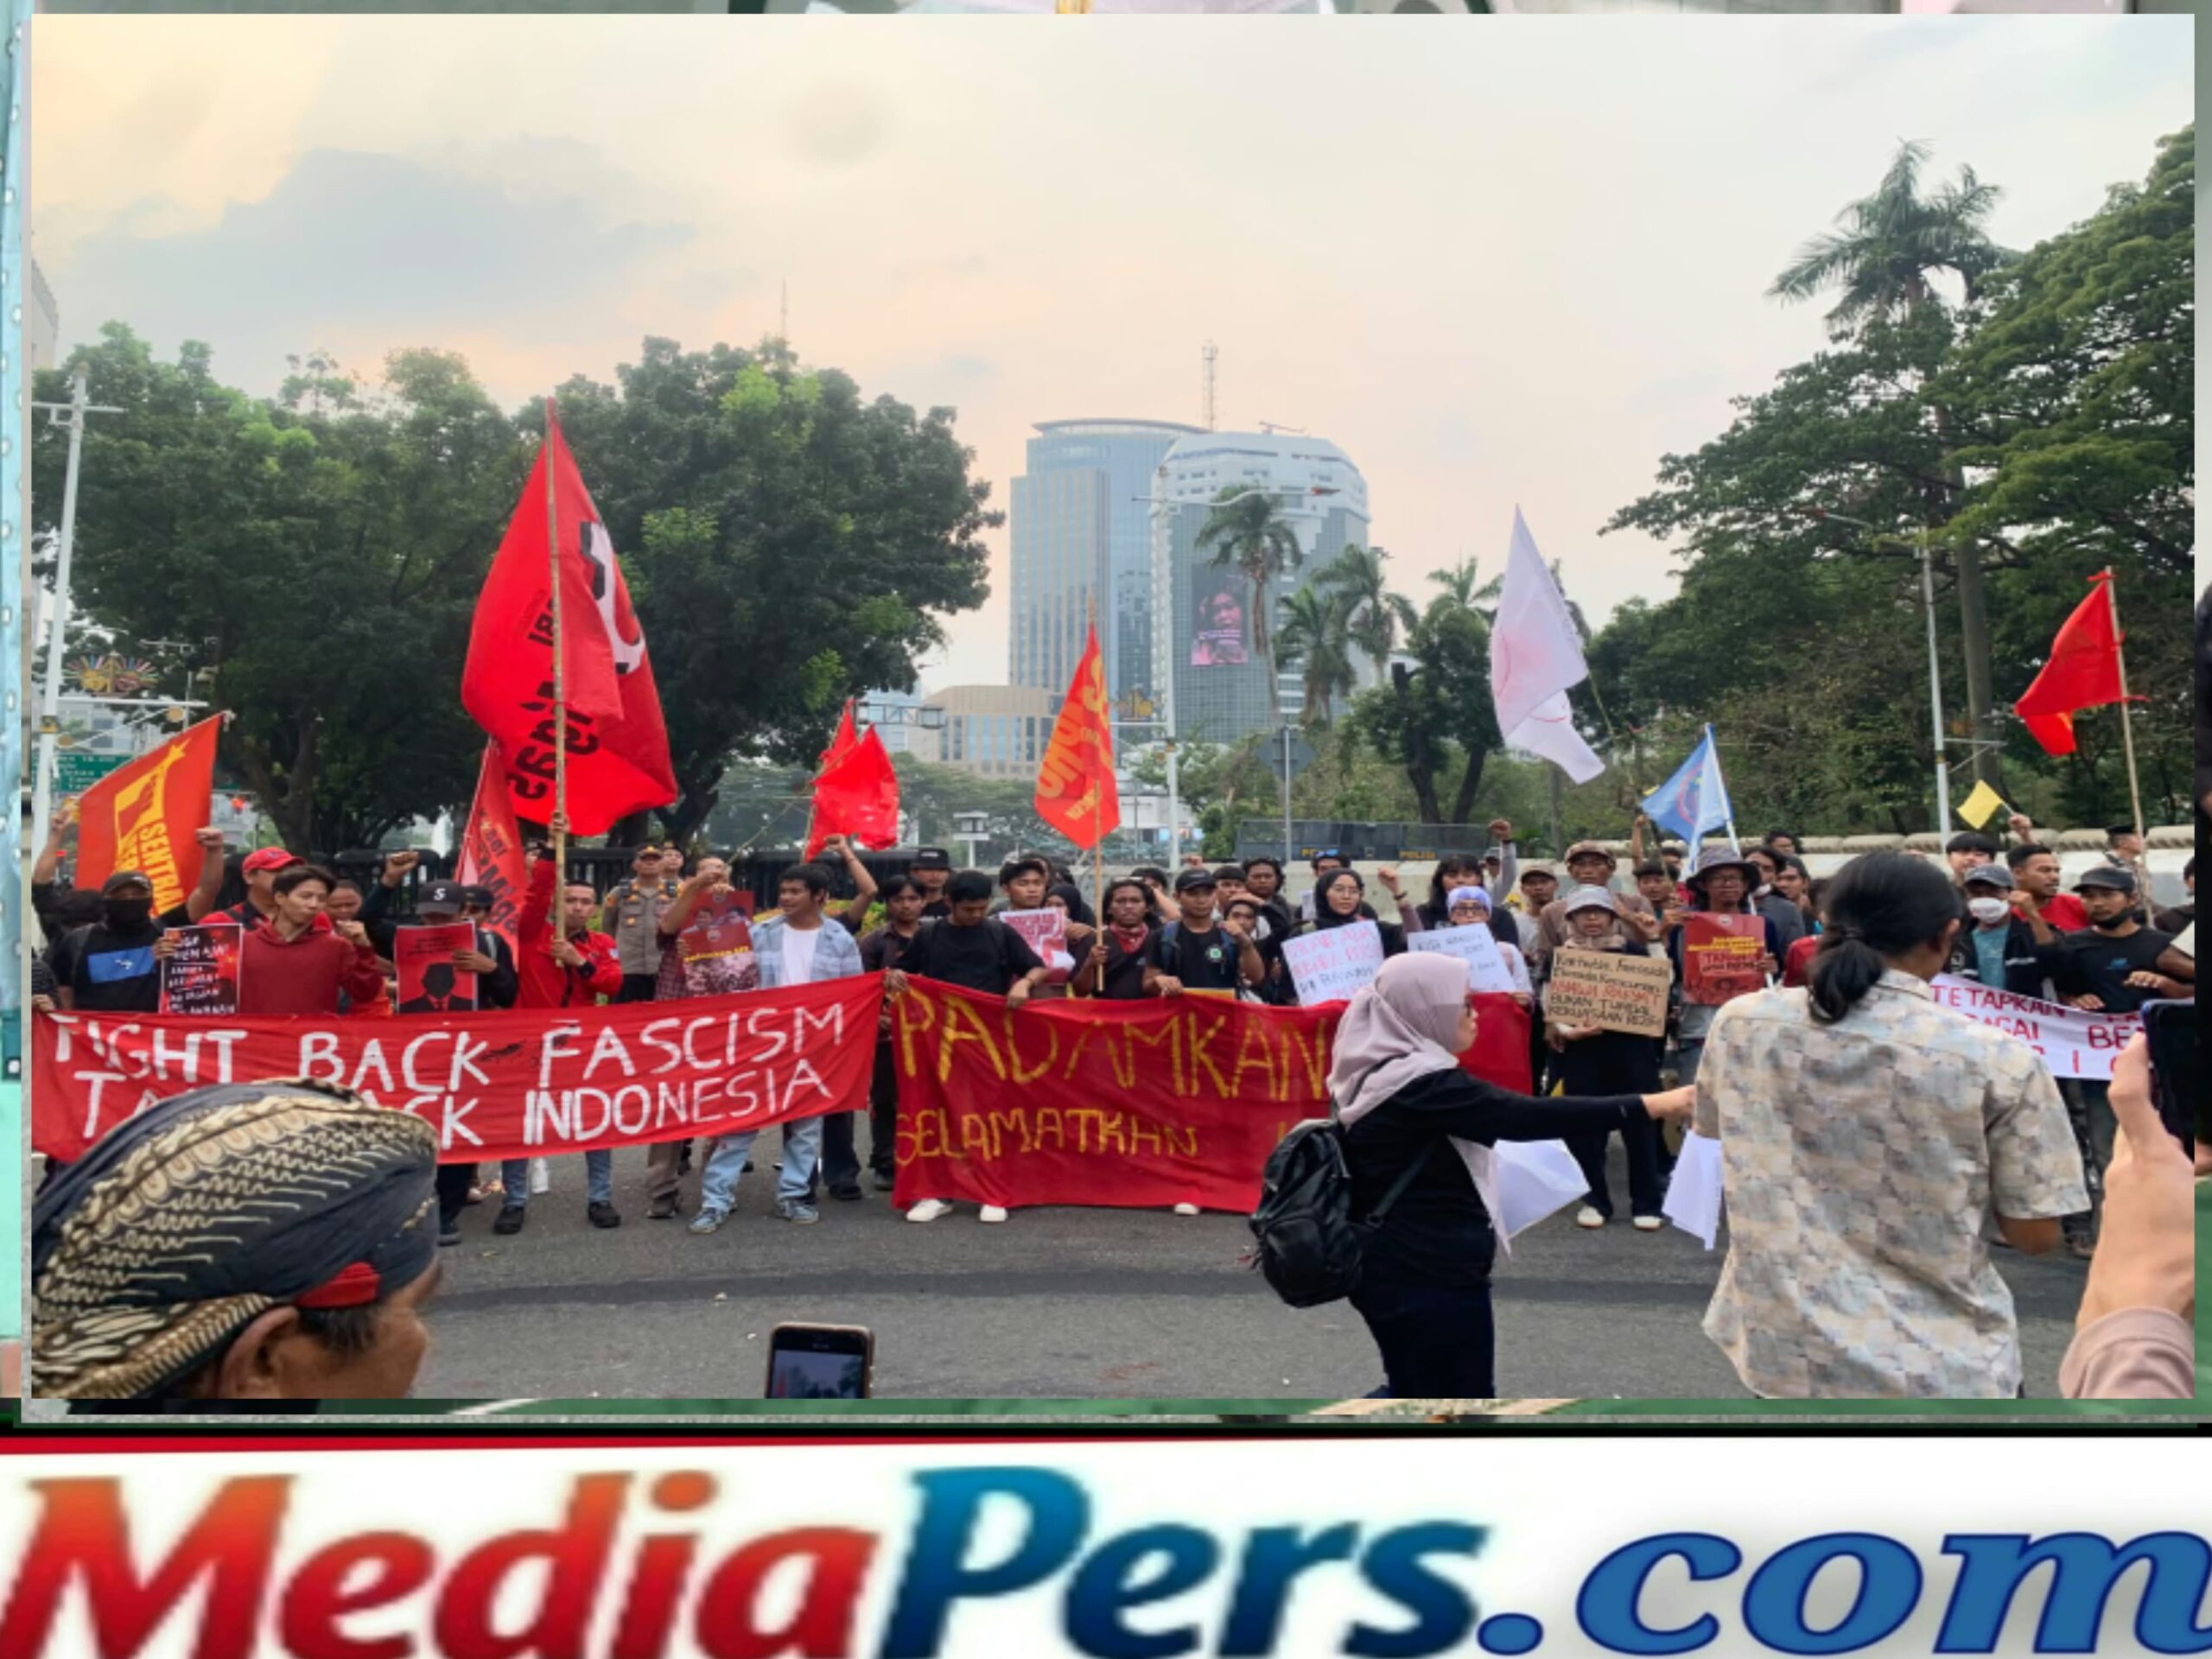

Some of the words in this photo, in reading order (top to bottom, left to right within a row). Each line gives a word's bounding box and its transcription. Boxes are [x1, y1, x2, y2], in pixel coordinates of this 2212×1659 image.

[893, 985, 1328, 1101] PADAMKAN
[1930, 985, 2065, 1018] TETAPKAN
[299, 1032, 491, 1092] BACK
[539, 1003, 842, 1088] FASCISM
[523, 1058, 834, 1145] INDONESIA
